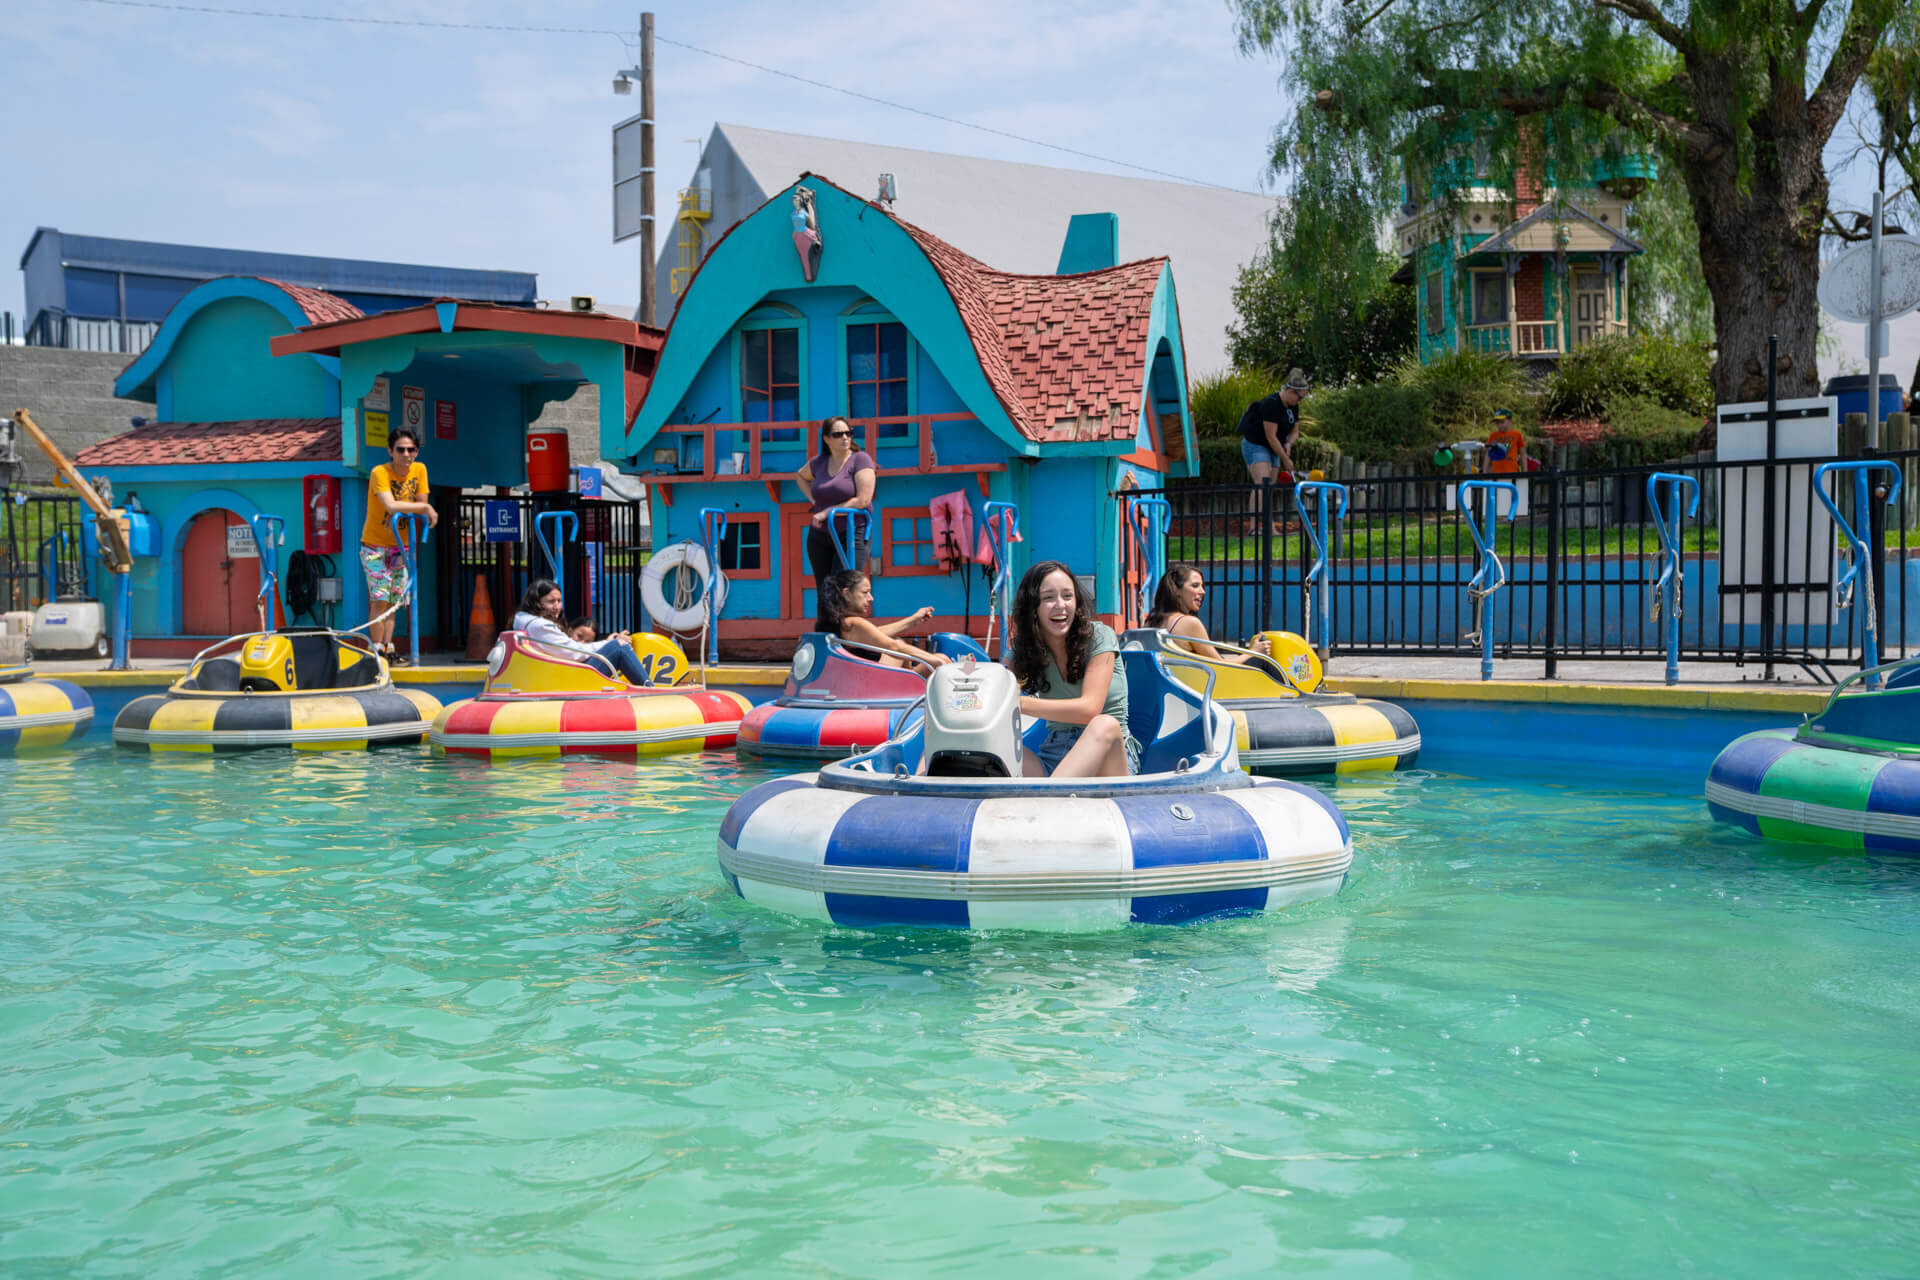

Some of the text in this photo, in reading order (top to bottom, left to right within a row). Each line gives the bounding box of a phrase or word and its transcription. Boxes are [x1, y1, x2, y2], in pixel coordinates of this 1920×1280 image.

[229, 528, 252, 538] NOTI
[284, 657, 294, 686] 6
[642, 654, 676, 684] 12
[1012, 706, 1022, 763] 8
